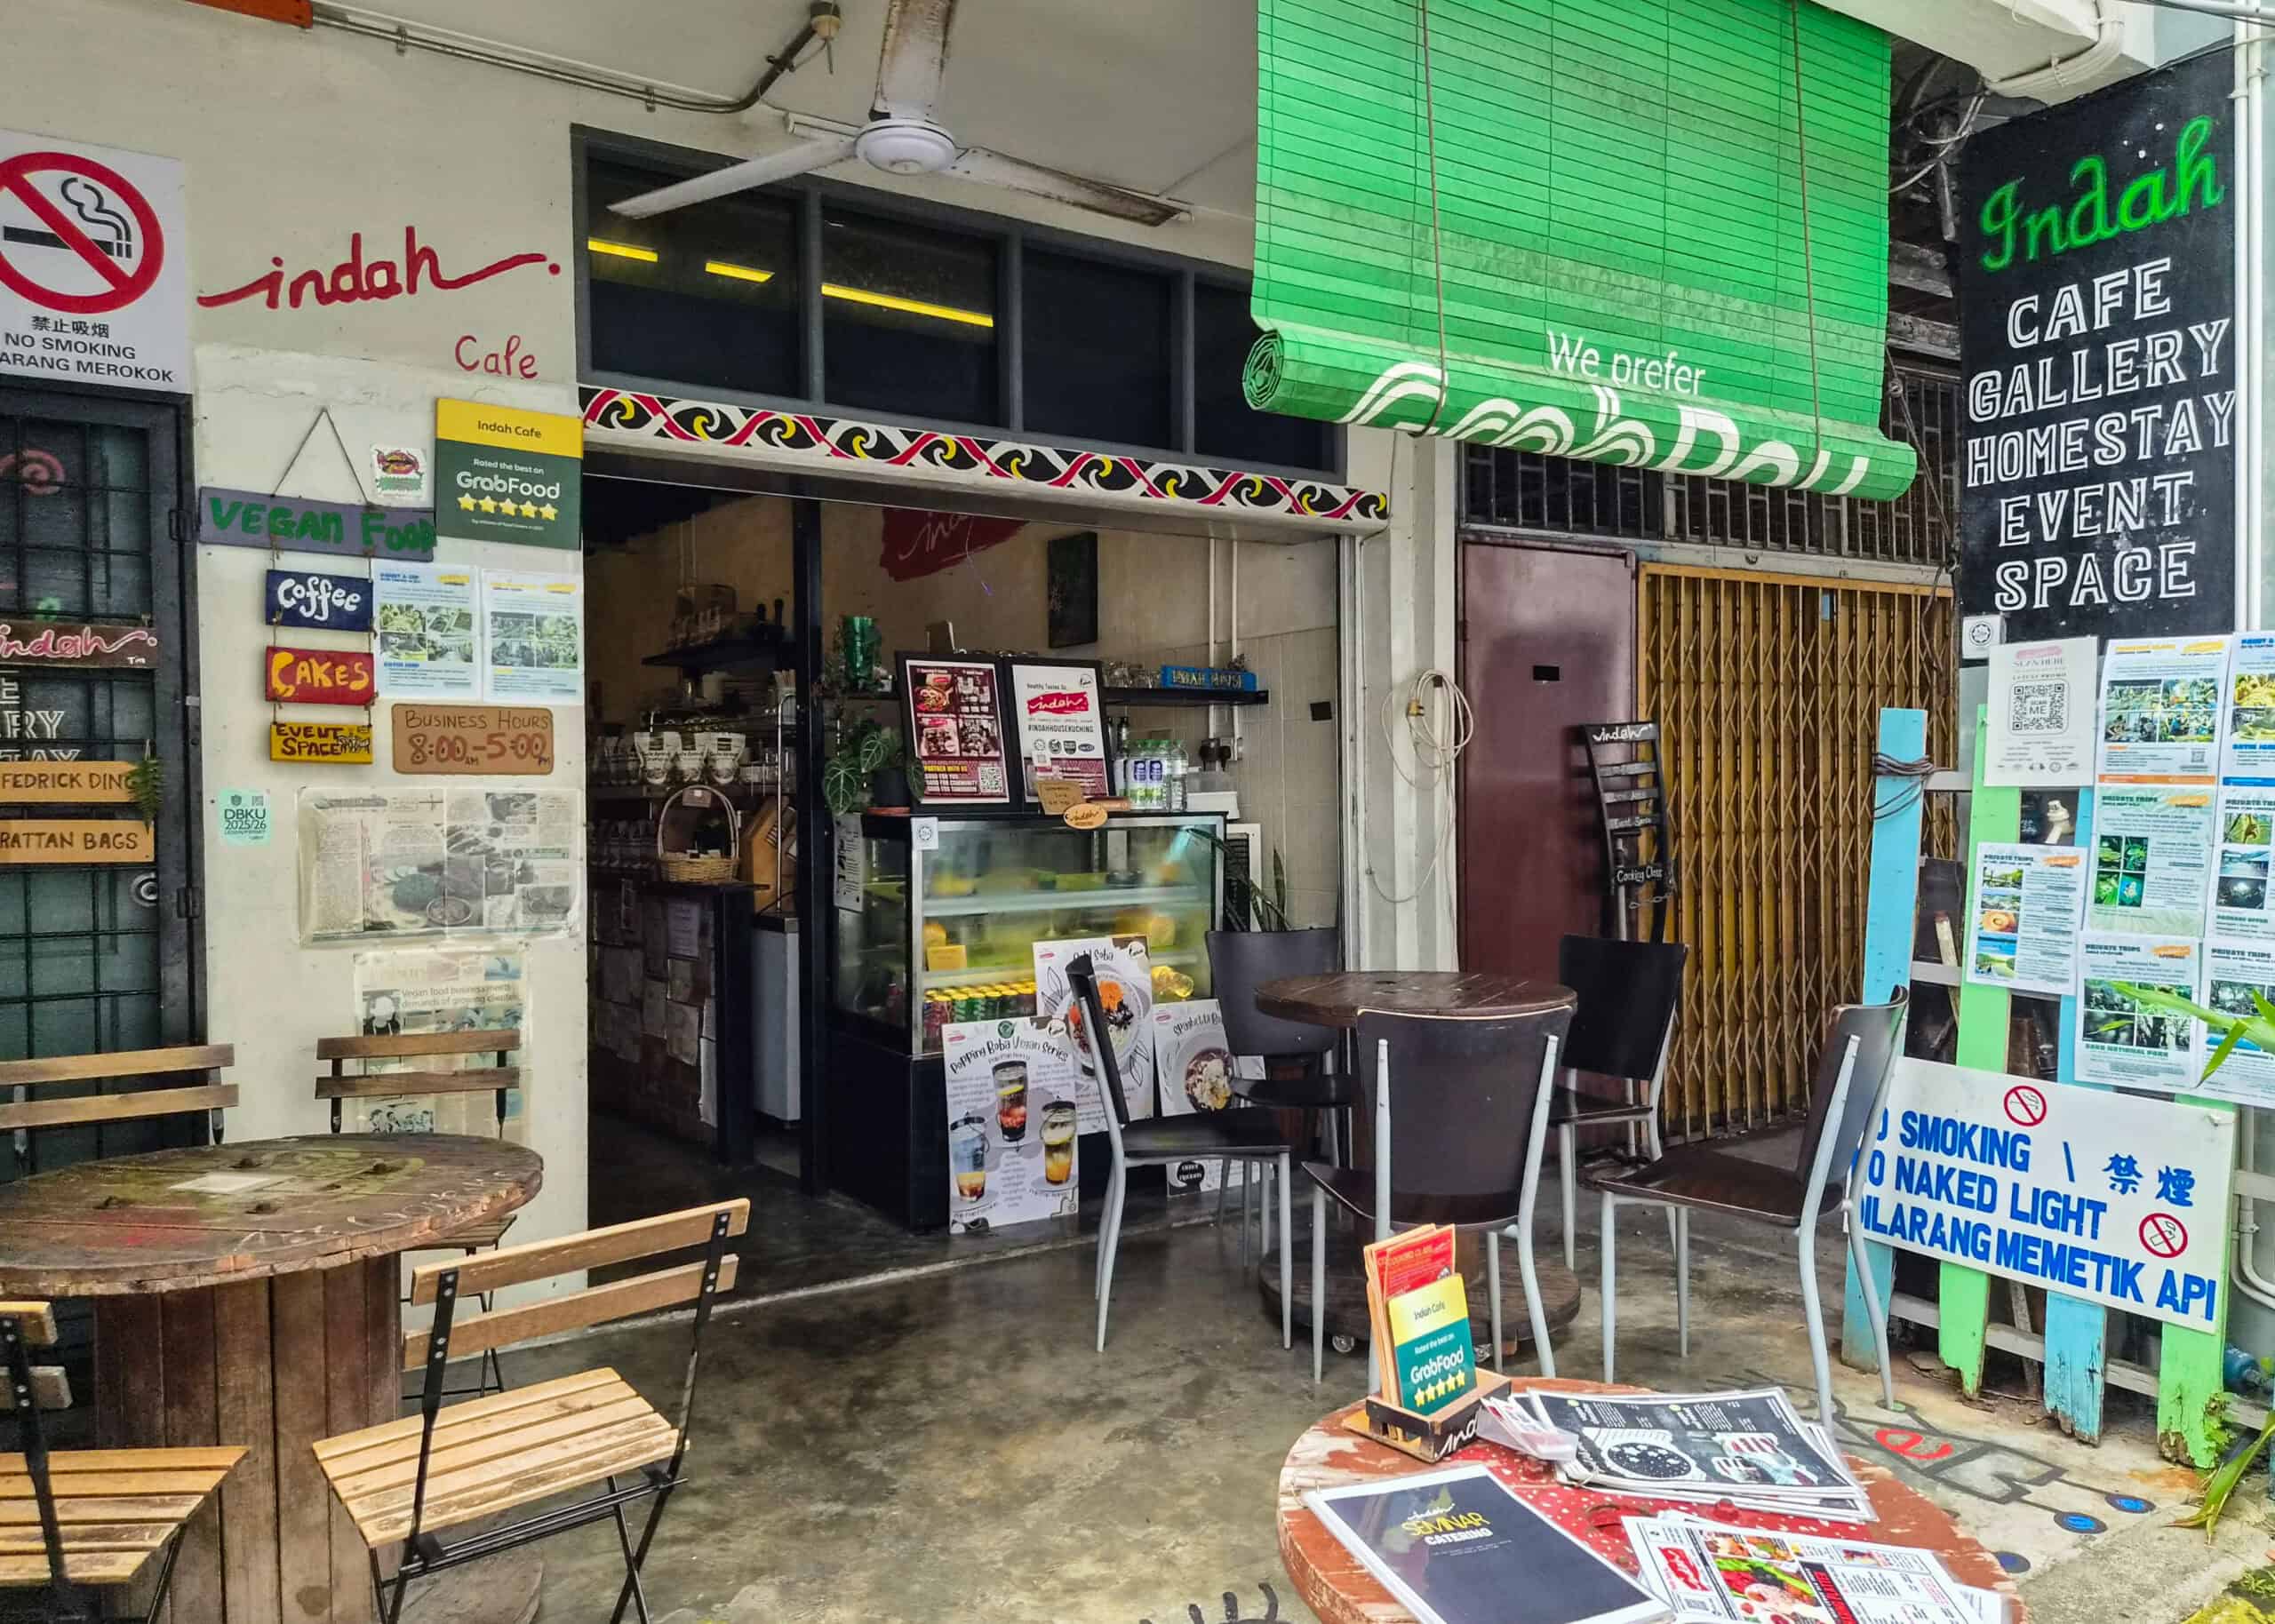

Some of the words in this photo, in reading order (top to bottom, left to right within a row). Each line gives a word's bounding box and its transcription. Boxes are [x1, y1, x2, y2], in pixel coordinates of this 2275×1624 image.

[1980, 115, 2225, 271] Indah
[2007, 257, 2172, 349] CAFE
[32, 315, 109, 338] 禁止吸烟
[4, 332, 35, 347] NO
[42, 337, 136, 359] SMOKING
[454, 334, 539, 379] Cafe
[76, 360, 173, 383] MEROKOK
[1546, 330, 1600, 378] We
[1611, 350, 1706, 396] prefer
[1968, 318, 2231, 423] GALLERY
[477, 419, 512, 434] Indah
[515, 425, 542, 439] Cafe
[1967, 390, 2236, 488] HOMESTAY
[473, 458, 499, 469] Rated
[499, 461, 514, 471] the
[515, 463, 532, 474] best
[533, 466, 545, 476] on
[456, 471, 561, 500] GrabFood
[1999, 471, 2194, 547] EVENT
[1995, 541, 2196, 611] SPACE
[277, 576, 361, 622] Coffee
[405, 710, 488, 729] BUSINESS
[498, 710, 549, 730] HOURS
[2, 773, 83, 789] FEDRICK
[224, 808, 267, 819] DBKU
[224, 818, 267, 830] 2025/26
[84, 832, 138, 850] BAGS
[2211, 947, 2245, 956] PRIVATE
[2247, 950, 2271, 959] TRIPS
[1899, 1110, 2032, 1173] SMOKING
[1895, 1155, 1998, 1214] NAKED
[2009, 1182, 2107, 1240] LIGHT
[1861, 1196, 1992, 1263] ILARANG
[1996, 1228, 2145, 1304] MEMETIK
[2156, 1269, 2216, 1321] API
[1409, 1343, 1465, 1384] GrabFood
[1401, 1512, 1491, 1536] SEMINAR
[1424, 1527, 1494, 1546] CATERING
